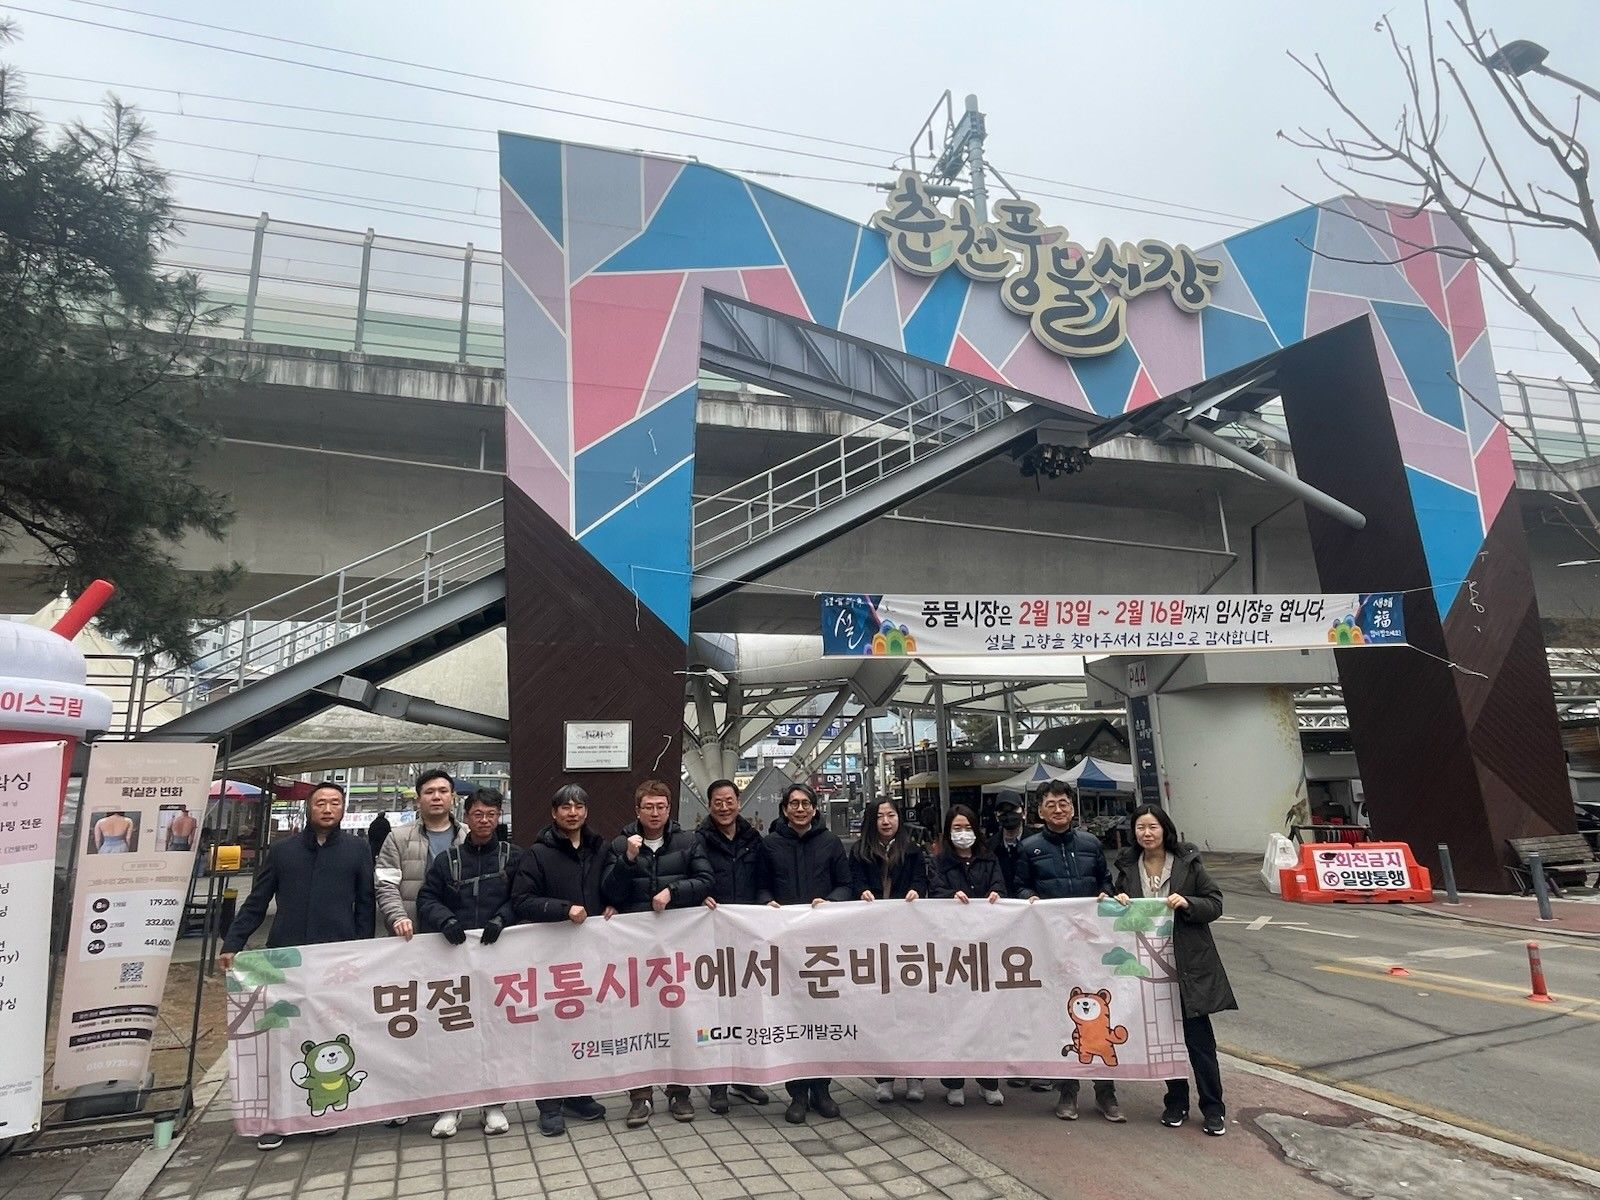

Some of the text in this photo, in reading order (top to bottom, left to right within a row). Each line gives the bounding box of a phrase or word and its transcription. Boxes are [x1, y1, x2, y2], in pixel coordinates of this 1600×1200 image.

[878, 174, 1221, 352] 춘천풍물시장
[921, 598, 1327, 628] 풍물시장은 2월 13일 ~ 2월 16일까지 임시장을 엽니다.
[1372, 596, 1394, 609] 새해
[834, 608, 865, 650] 설
[1373, 610, 1392, 628] 福
[985, 629, 1273, 651] 설날 고향을 찾아주셔서 진심으로 감사합니다.
[121, 786, 183, 798] 확실한 변화
[20, 817, 43, 830] 전문
[1340, 869, 1406, 887] 일방통행
[372, 941, 1043, 1039] 명절 전통시장에서 준비하세요
[710, 1023, 858, 1045] GJC 강원중도개발공사
[570, 1031, 671, 1060] 강원특별자치도
